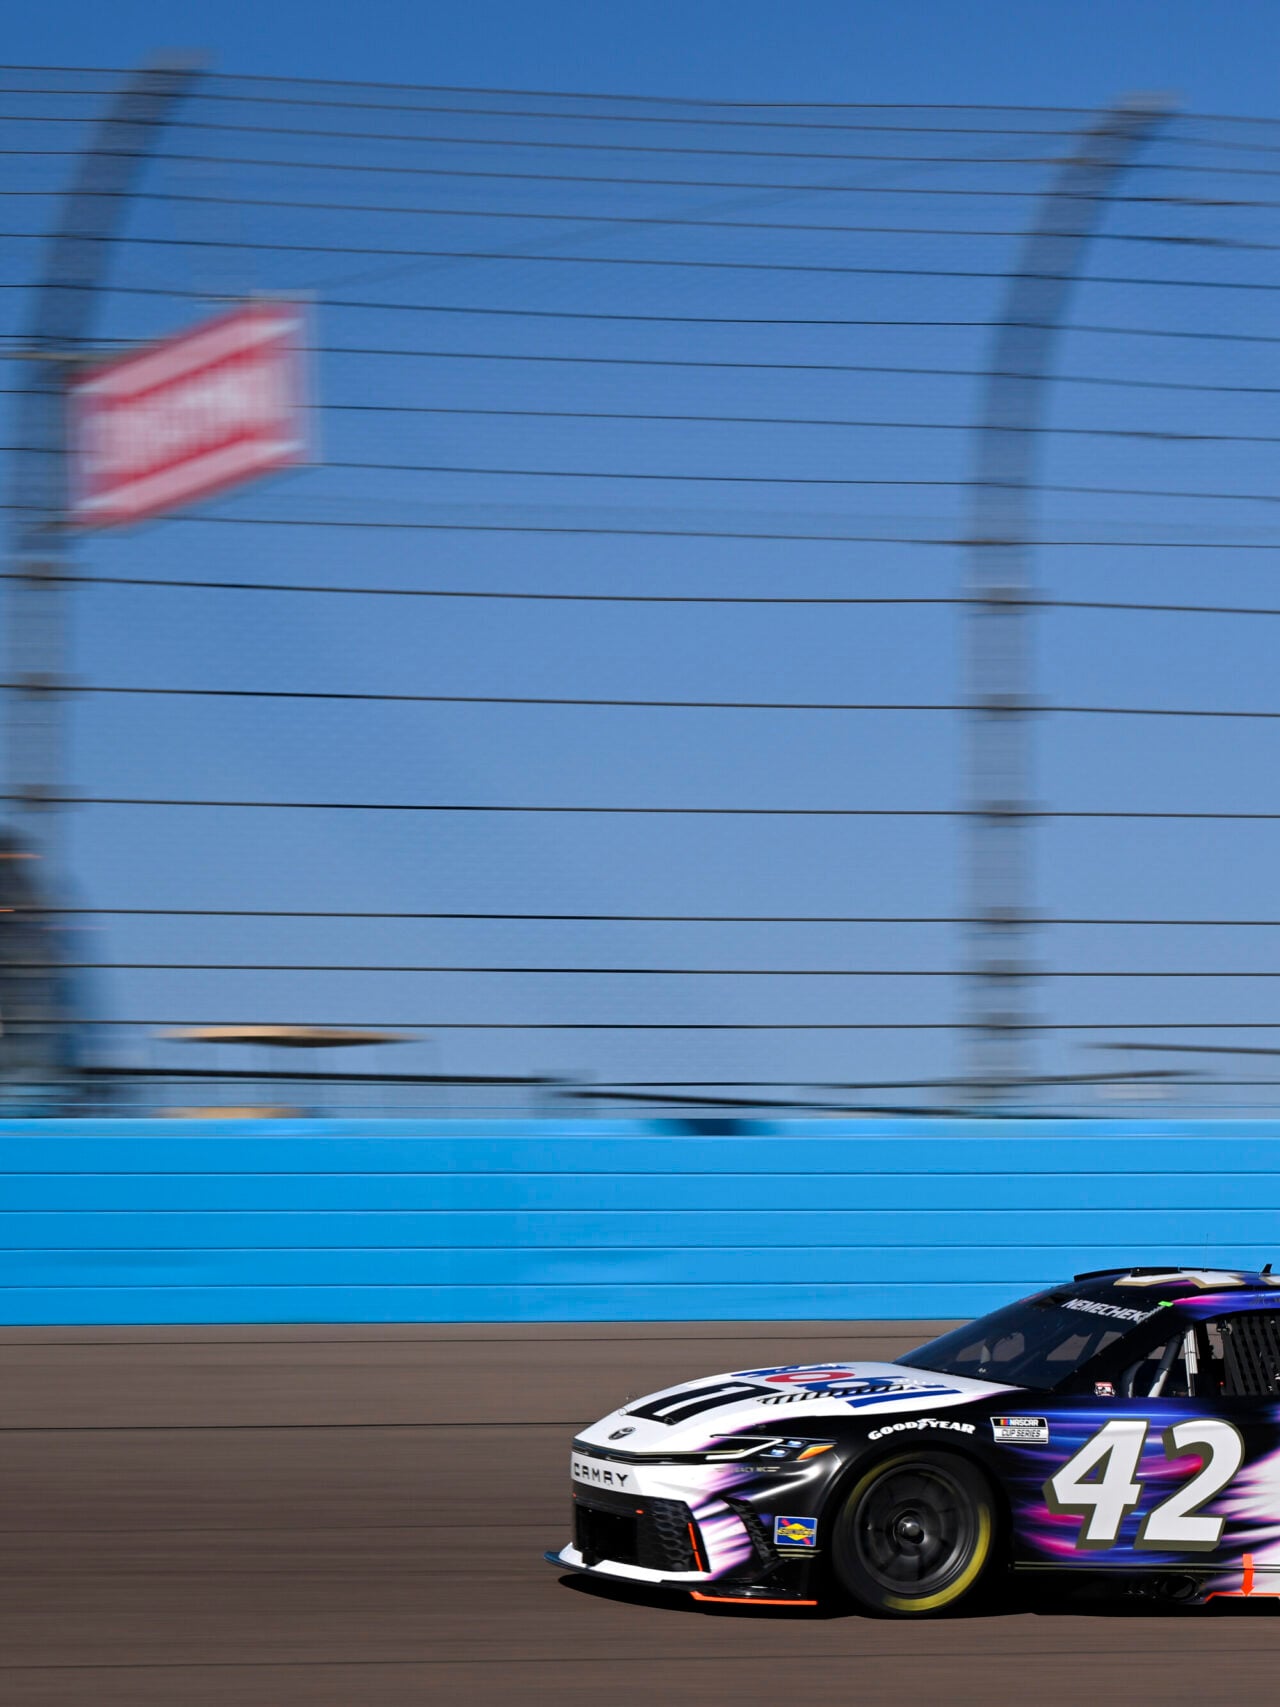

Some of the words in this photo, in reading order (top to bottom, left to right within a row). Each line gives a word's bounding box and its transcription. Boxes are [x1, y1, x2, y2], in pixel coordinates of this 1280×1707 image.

[1061, 1299, 1142, 1321] NEMECHEK
[868, 1418, 976, 1440] GOODYEAR
[1011, 1418, 1039, 1427] NASCAR
[1016, 1429, 1041, 1438] SERIES
[574, 1462, 628, 1488] CAMRY
[1045, 1419, 1243, 1548] 42
